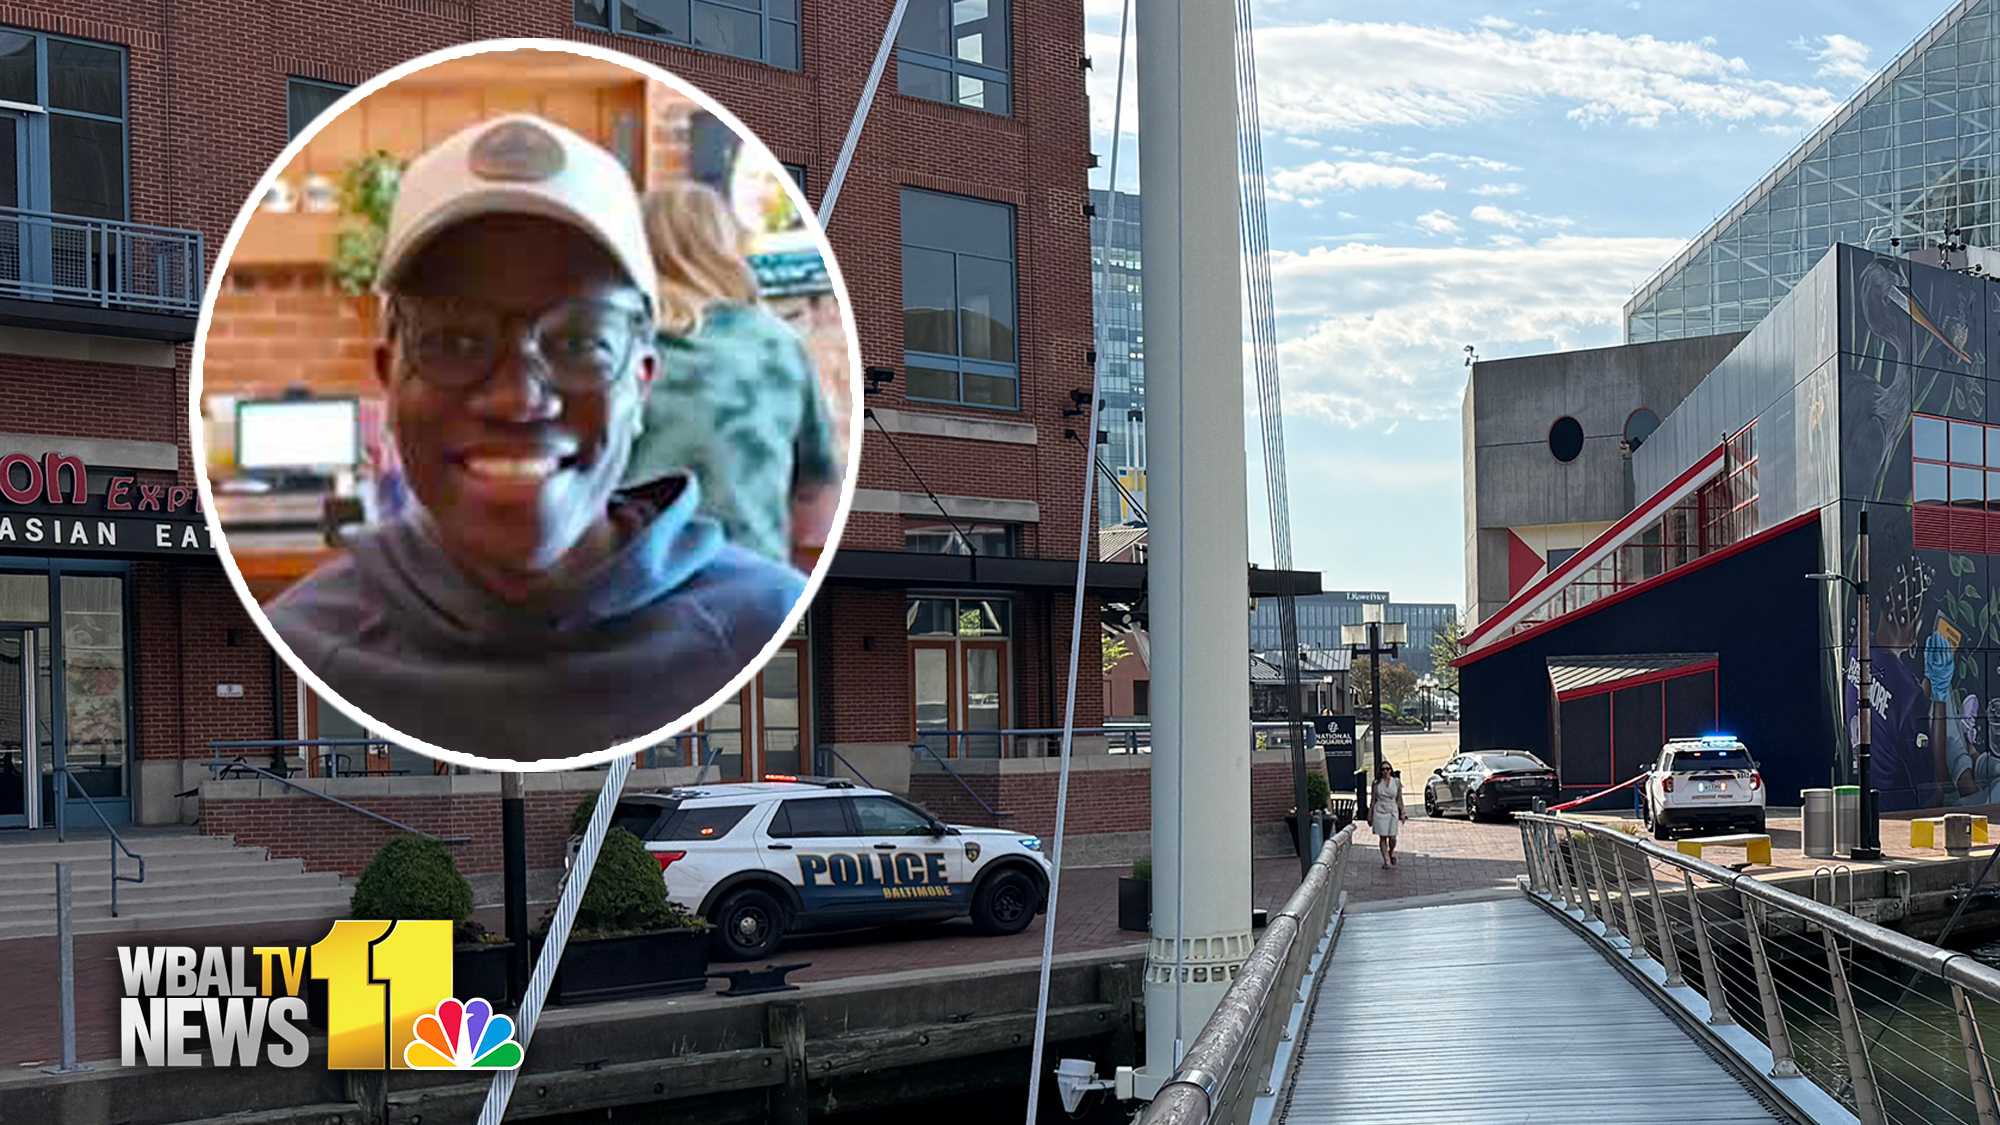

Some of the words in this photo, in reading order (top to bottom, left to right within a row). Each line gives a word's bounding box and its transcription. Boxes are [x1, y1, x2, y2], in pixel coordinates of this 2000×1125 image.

[0, 516, 117, 546] ASIAN
[796, 852, 950, 886] POLICE
[882, 885, 952, 899] BALTIMORE
